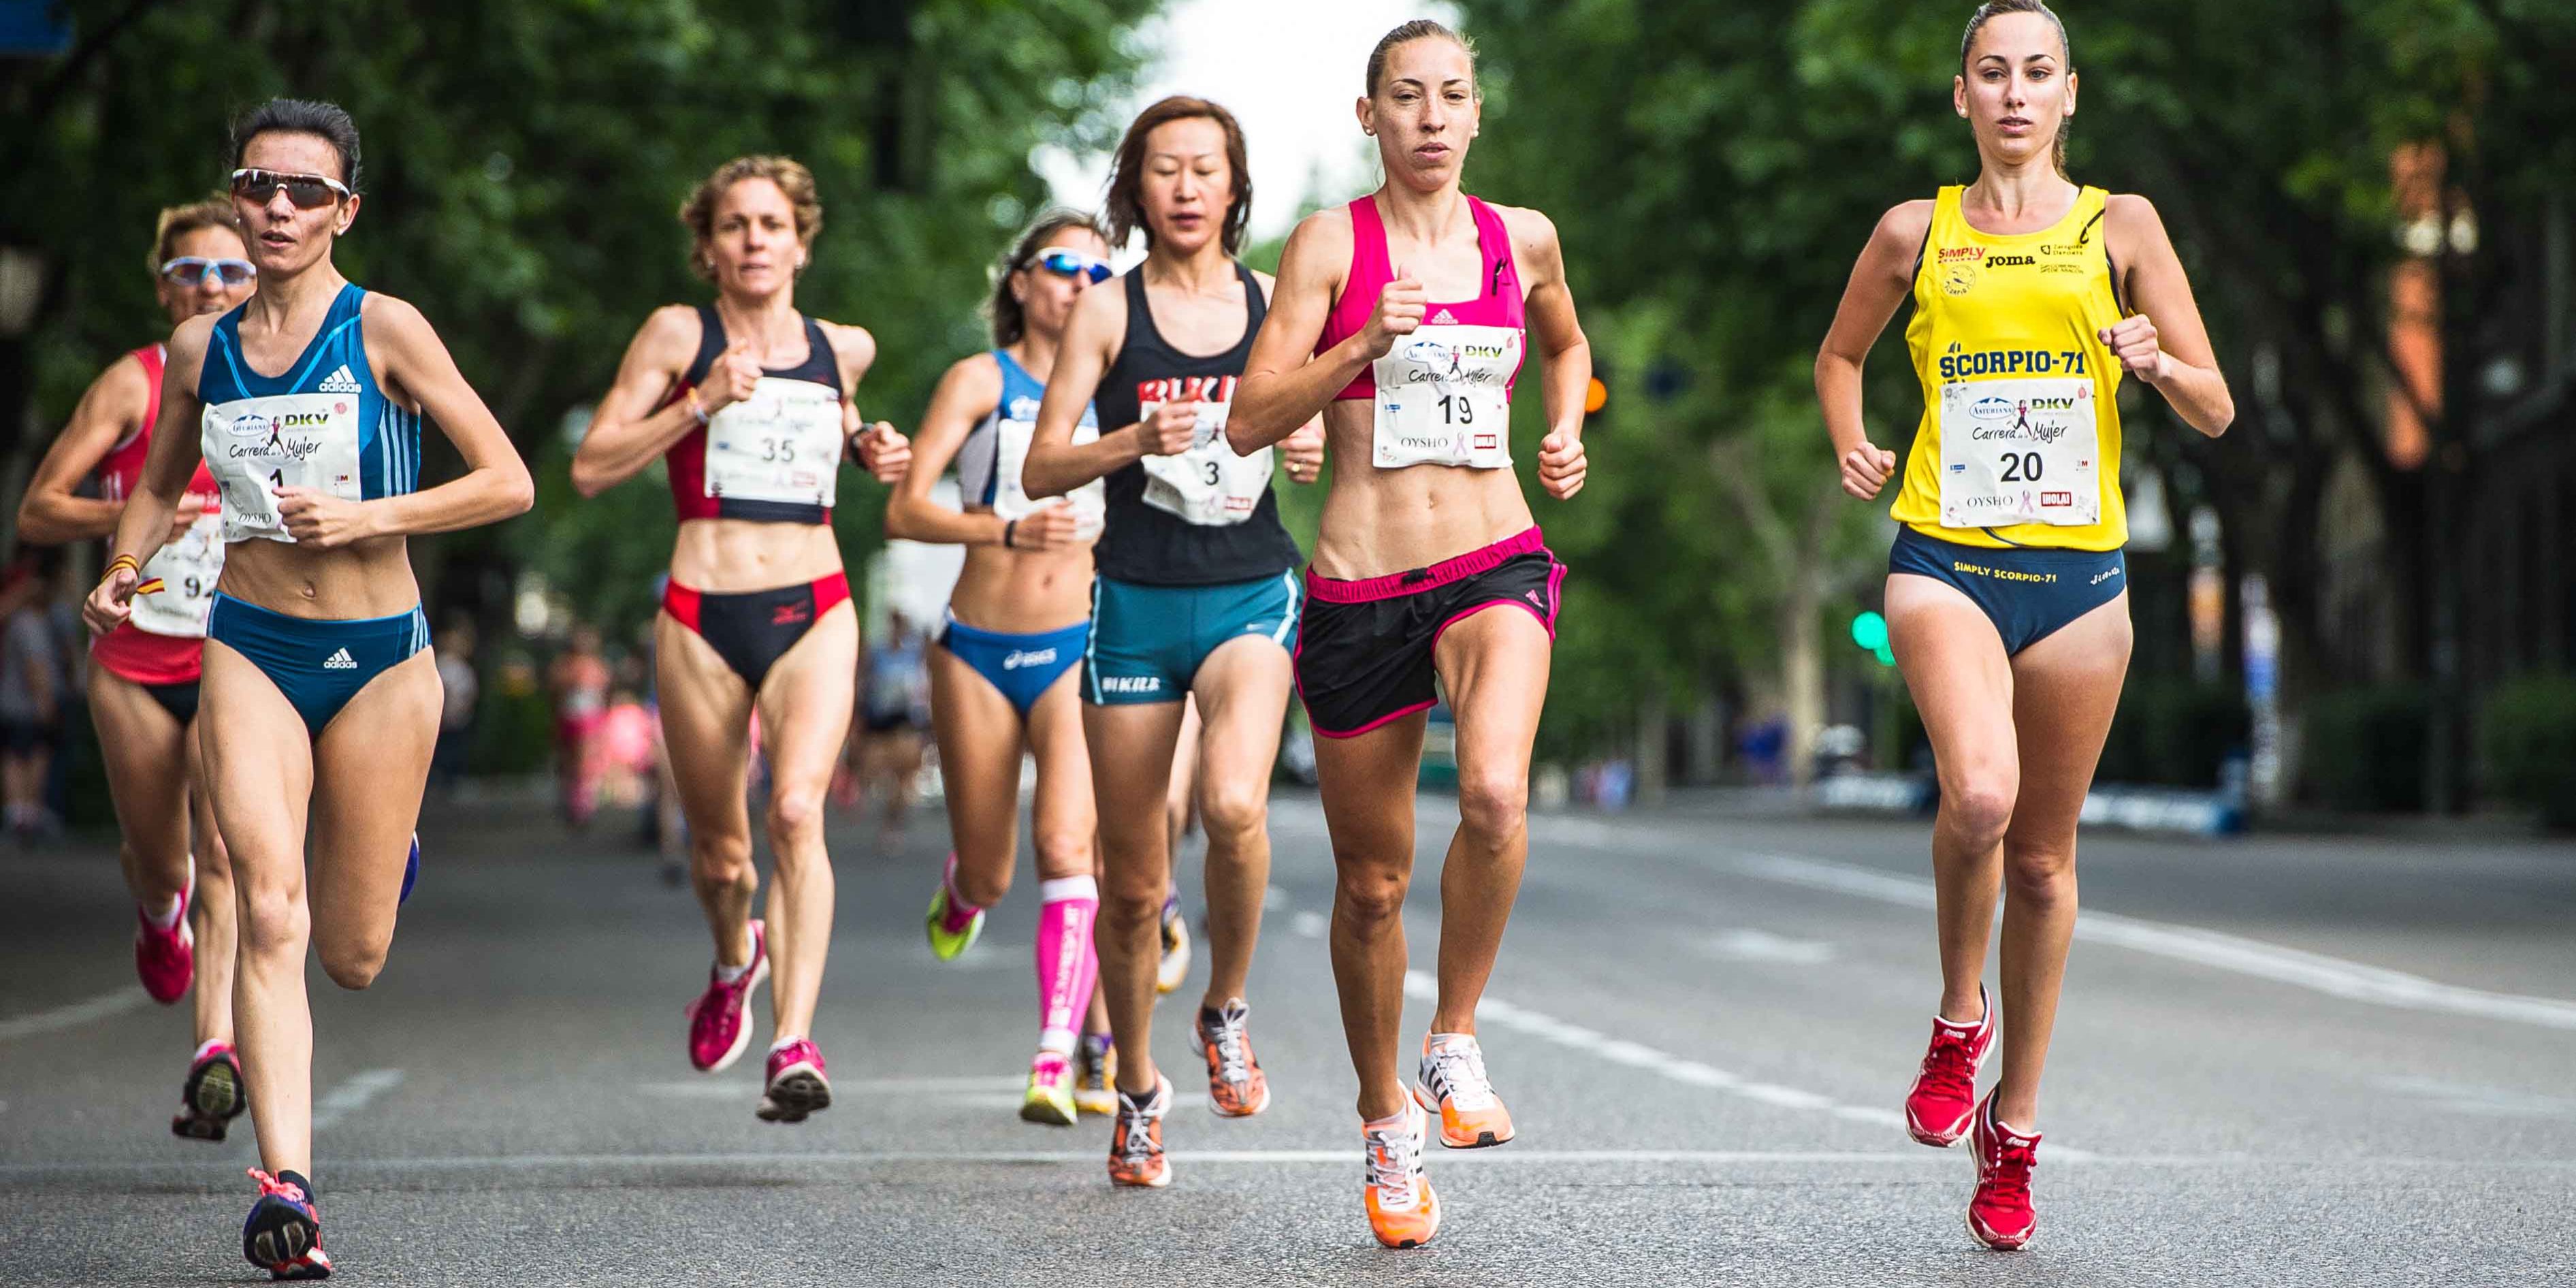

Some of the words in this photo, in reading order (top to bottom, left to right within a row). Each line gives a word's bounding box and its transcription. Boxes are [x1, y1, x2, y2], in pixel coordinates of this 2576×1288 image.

[1465, 345, 1502, 358] DKV
[1939, 351, 2084, 378] SCORPIO-71
[319, 382, 362, 393] adidas
[1438, 395, 1472, 425] 19
[2031, 398, 2074, 410] DKV
[285, 413, 329, 426] DKV
[1972, 427, 2016, 440] Carrera
[2033, 419, 2068, 444] Mujer
[229, 443, 270, 458] Carrera
[285, 436, 322, 461] Mujer
[761, 437, 795, 463] 35
[1400, 437, 1449, 448] OYSHO
[1204, 461, 1219, 485] 3
[2000, 451, 2043, 483] 20
[270, 468, 284, 488] 1
[1967, 496, 2013, 508] OYSHO
[1954, 562, 1991, 576] SIMPLY
[1994, 569, 2057, 583] SCORPIO-71
[323, 660, 358, 669] adidas
